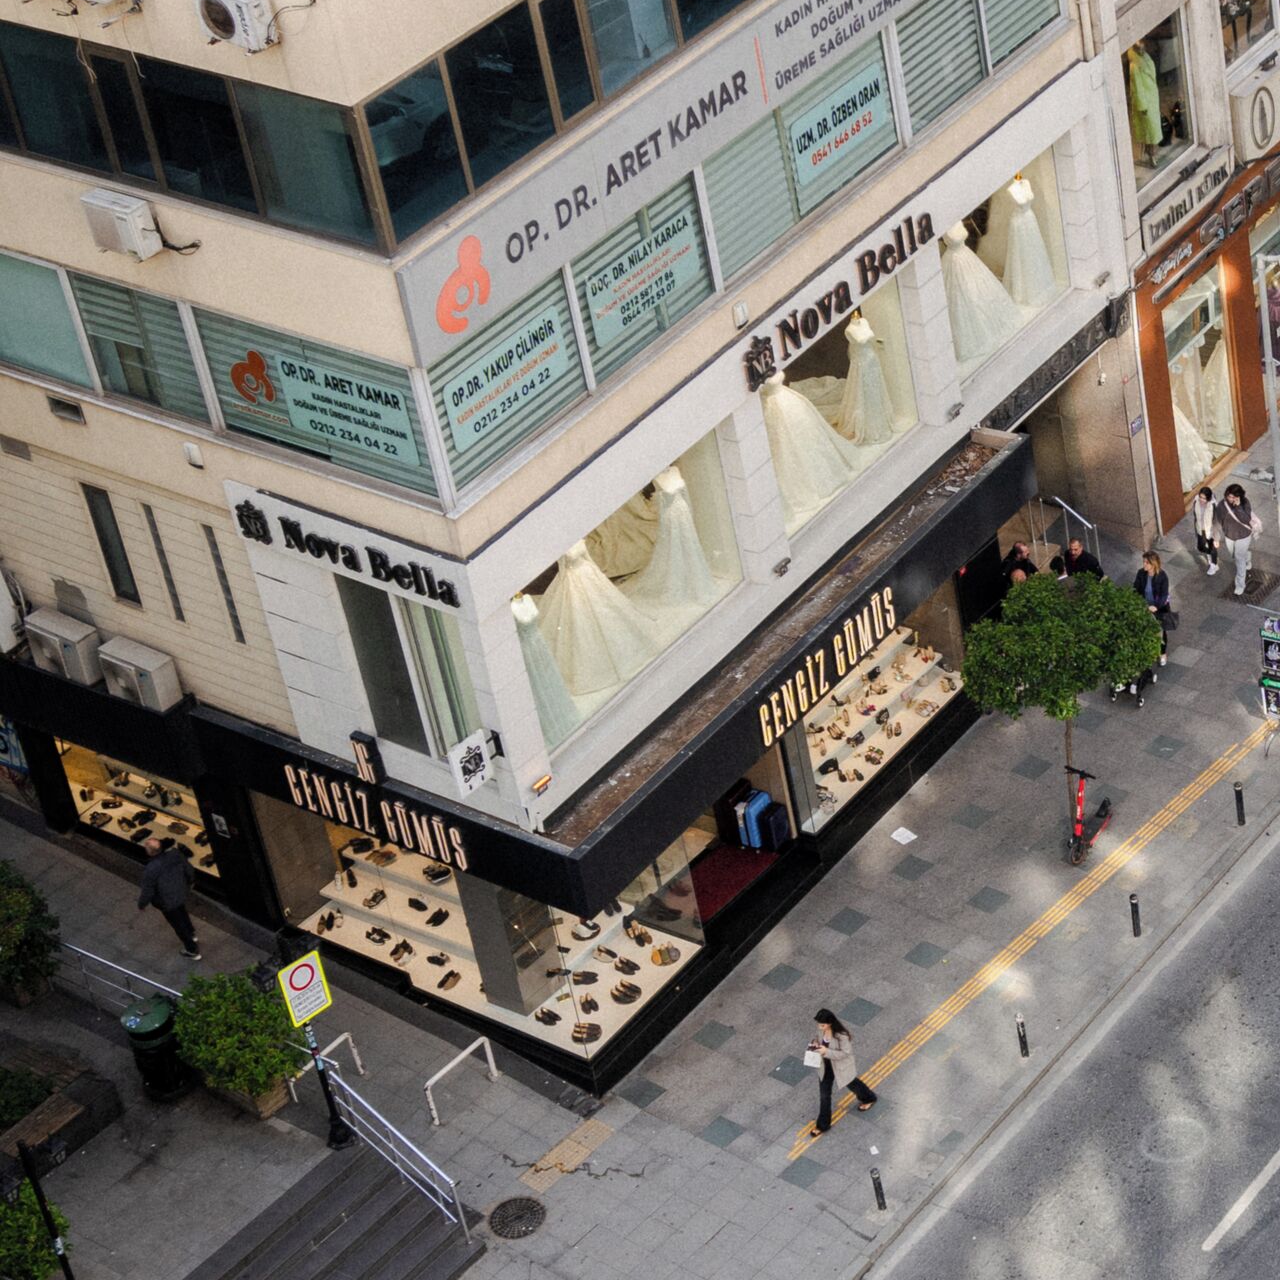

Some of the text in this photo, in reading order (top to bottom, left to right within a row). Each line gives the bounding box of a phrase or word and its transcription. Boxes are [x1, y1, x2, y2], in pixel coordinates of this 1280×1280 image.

[774, 0, 813, 38] KADIN
[811, 0, 854, 38] DOĞUM
[775, 51, 817, 90] ÜREME
[819, 12, 865, 59] SAĞLIĞI
[795, 78, 881, 155] UZM. DR. ÖZBEN ORAN
[811, 111, 873, 167] 0541 646 68 52
[505, 70, 749, 264] OP. DR. ARET KAMAR
[1197, 165, 1229, 204] KÜRK
[590, 216, 689, 297] DOÇ. DR. NİLAY KARACA
[775, 212, 936, 361] Nova Bella
[620, 295, 640, 315] 0212
[655, 275, 663, 288] 17
[622, 279, 676, 326] 0544 772 53 07
[483, 349, 514, 383] YAKUP
[515, 319, 555, 361] ÇİLİNGİR
[293, 398, 408, 440] DOĞUM VE ÜREME SAĞLIĞI UZMANI
[312, 392, 381, 419] KADIN HASTALIKLARI
[324, 373, 353, 396] ARET
[356, 383, 402, 411] KAMAR
[474, 368, 551, 433] 0212 234 04 22
[310, 419, 399, 456] 0212 234 04 22
[278, 516, 461, 608] Nova Bella
[759, 649, 830, 748] CENGİZ
[284, 764, 376, 836] CENGİZ
